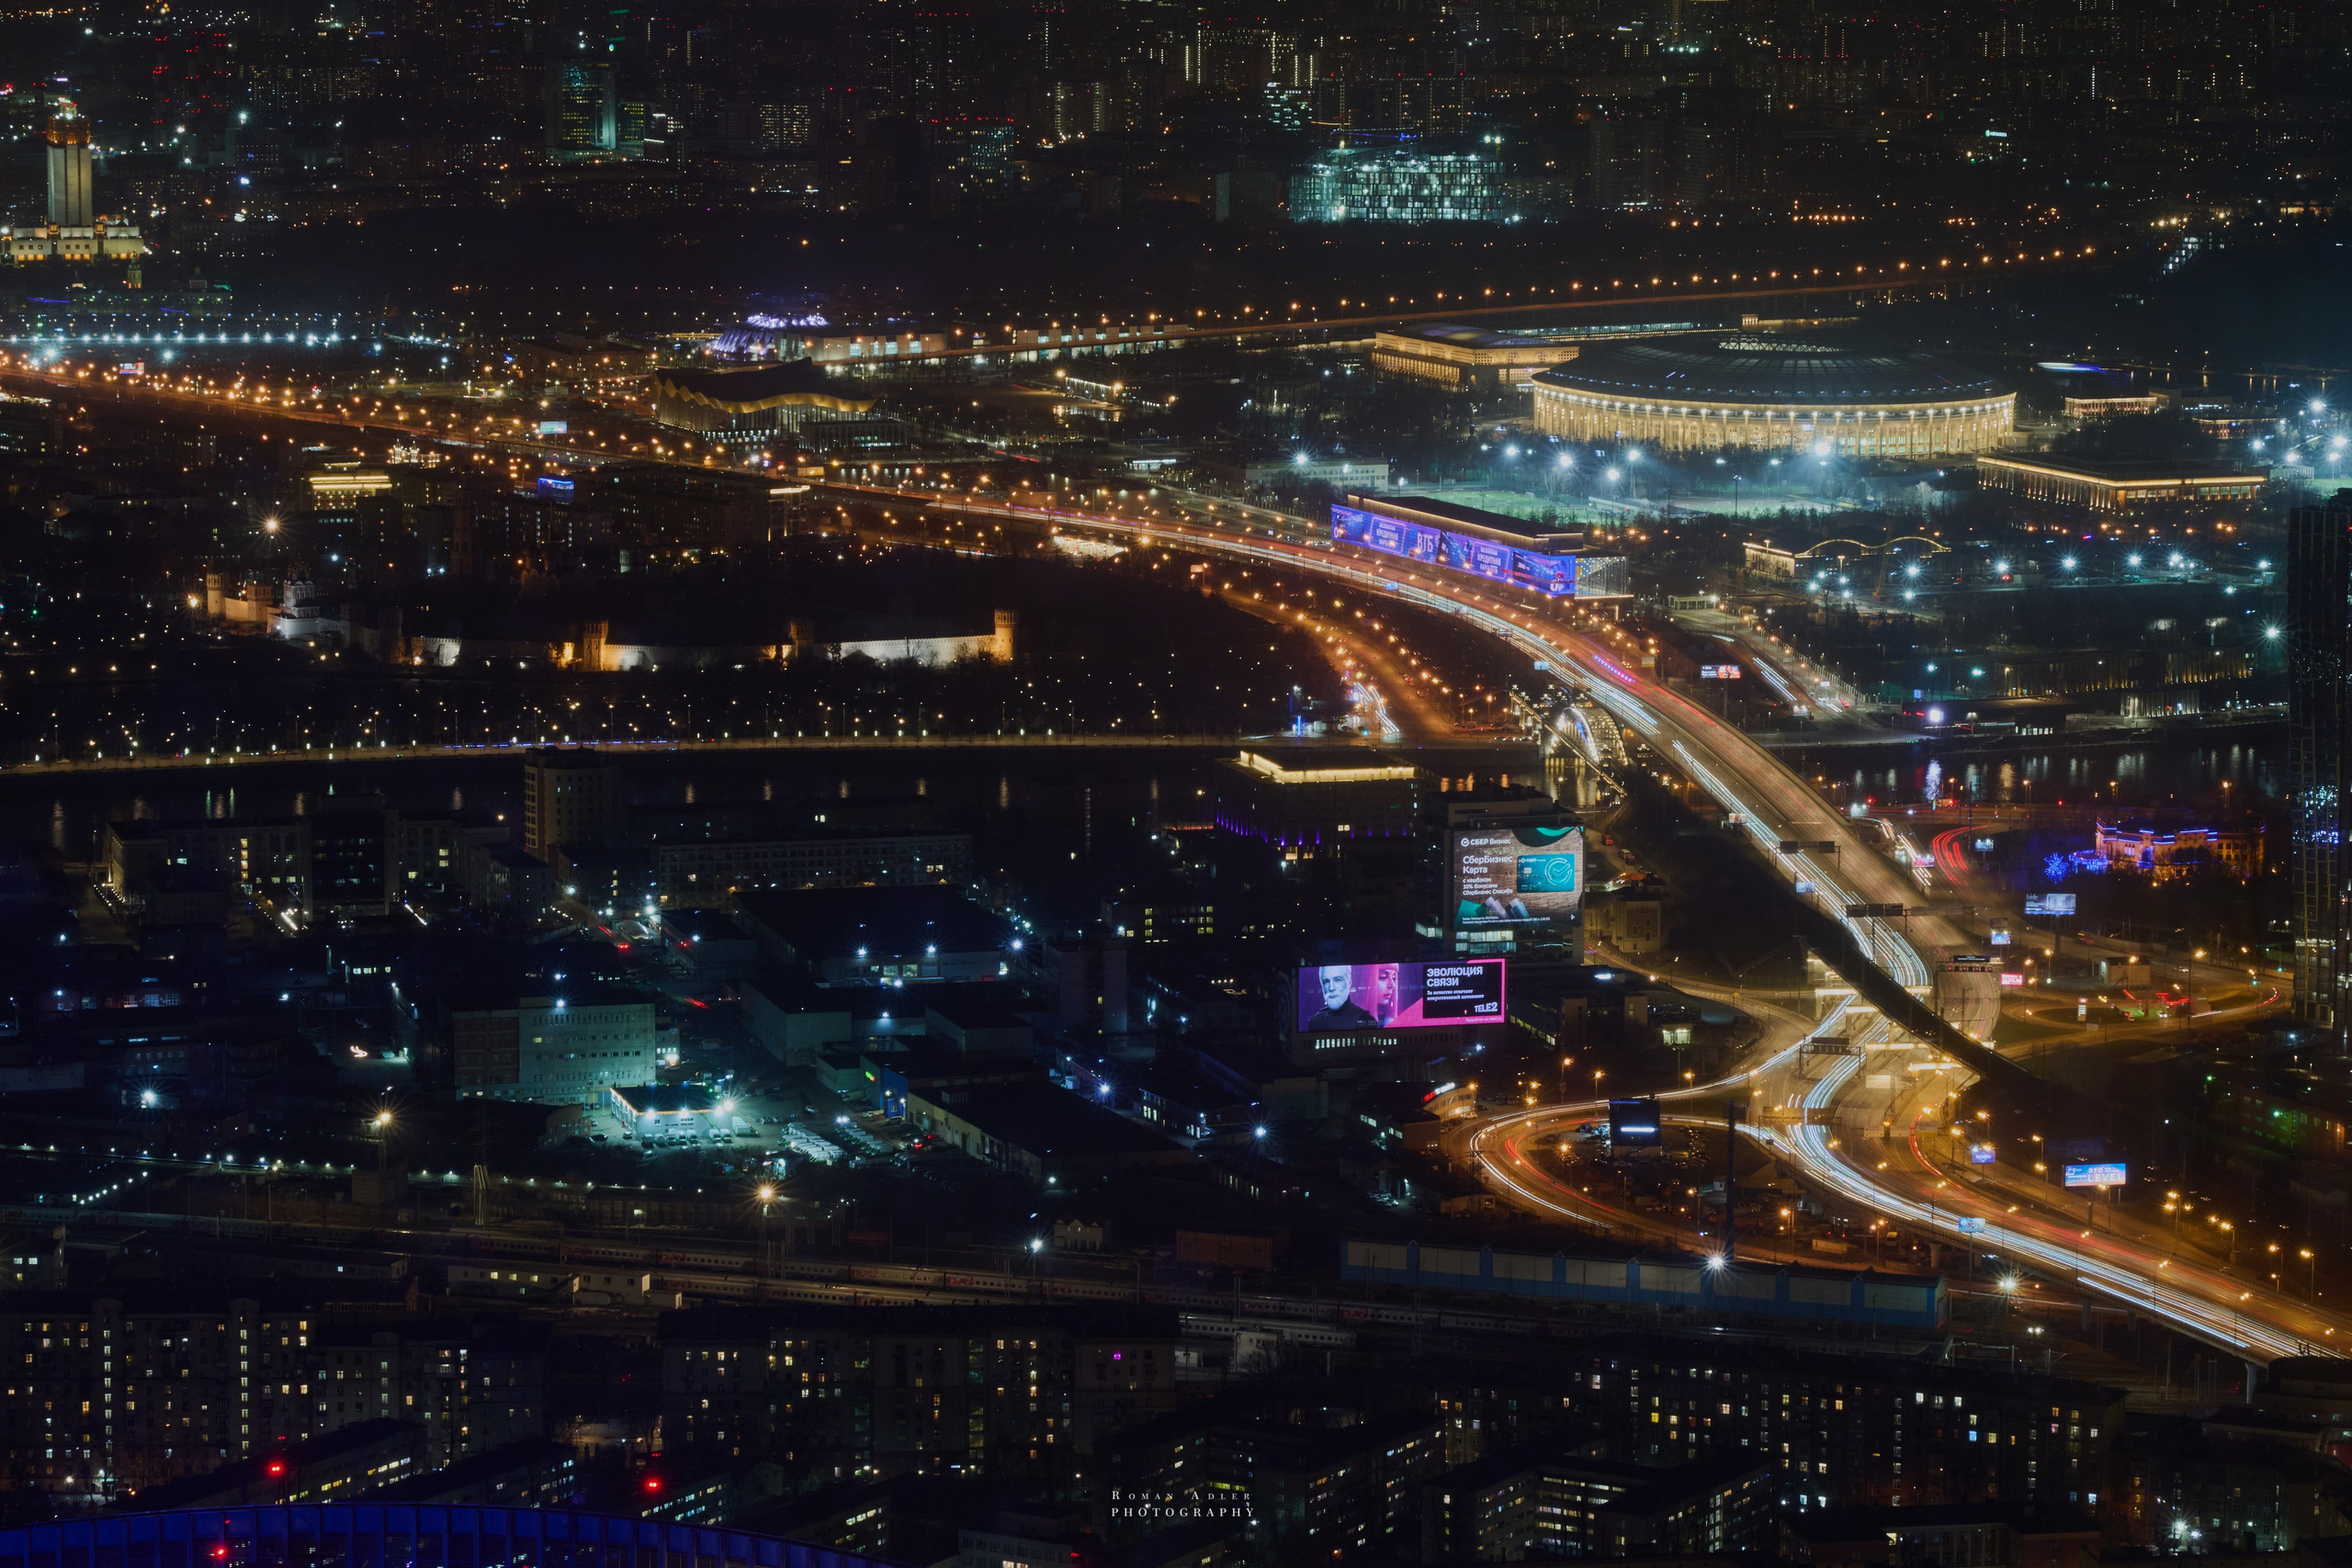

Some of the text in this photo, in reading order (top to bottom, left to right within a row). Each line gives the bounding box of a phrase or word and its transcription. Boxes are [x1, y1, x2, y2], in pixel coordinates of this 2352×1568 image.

[1417, 532, 1433, 553] ВТБ
[1463, 854, 1513, 864] СберБизнес
[1463, 866, 1487, 874] Карта
[1427, 966, 1483, 977] ЭВОЛЮЦИЯ
[1427, 977, 1459, 987] СВЯЗИ
[1474, 1001, 1498, 1013] TELE2
[2087, 1173, 2123, 1182] LEVEL
